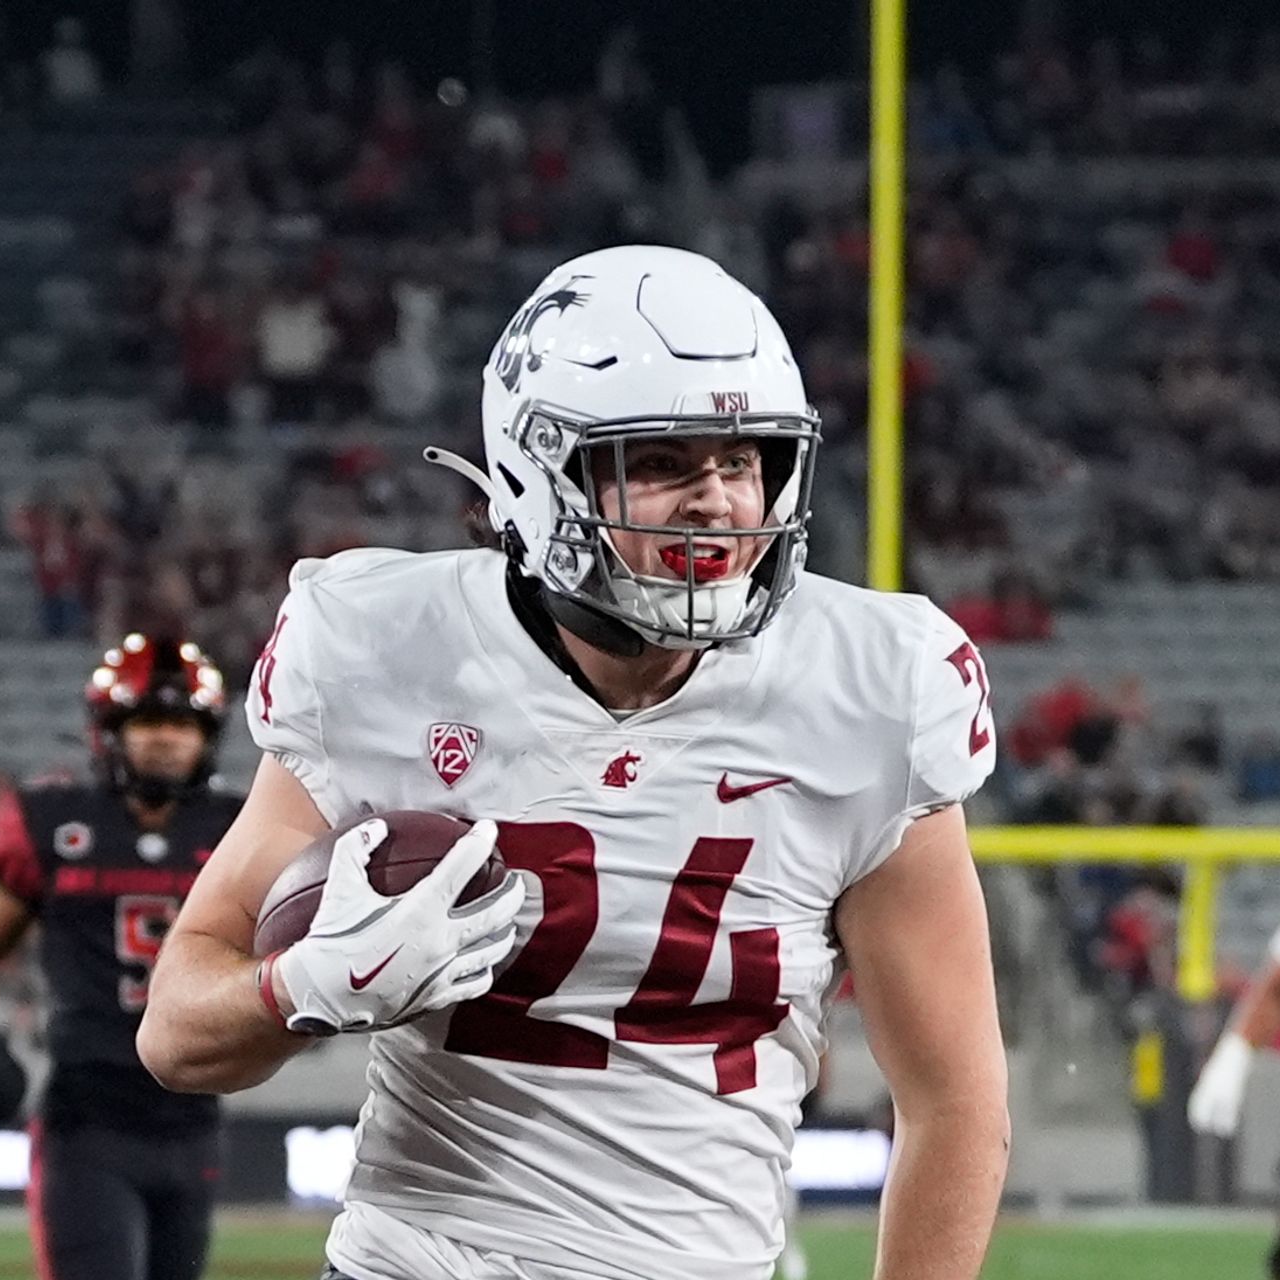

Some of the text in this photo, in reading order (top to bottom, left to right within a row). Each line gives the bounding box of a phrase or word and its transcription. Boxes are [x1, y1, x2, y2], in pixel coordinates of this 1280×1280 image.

[711, 391, 749, 413] WSU
[429, 724, 477, 763] PAC
[438, 748, 464, 774] 12
[444, 821, 790, 1095] 24
